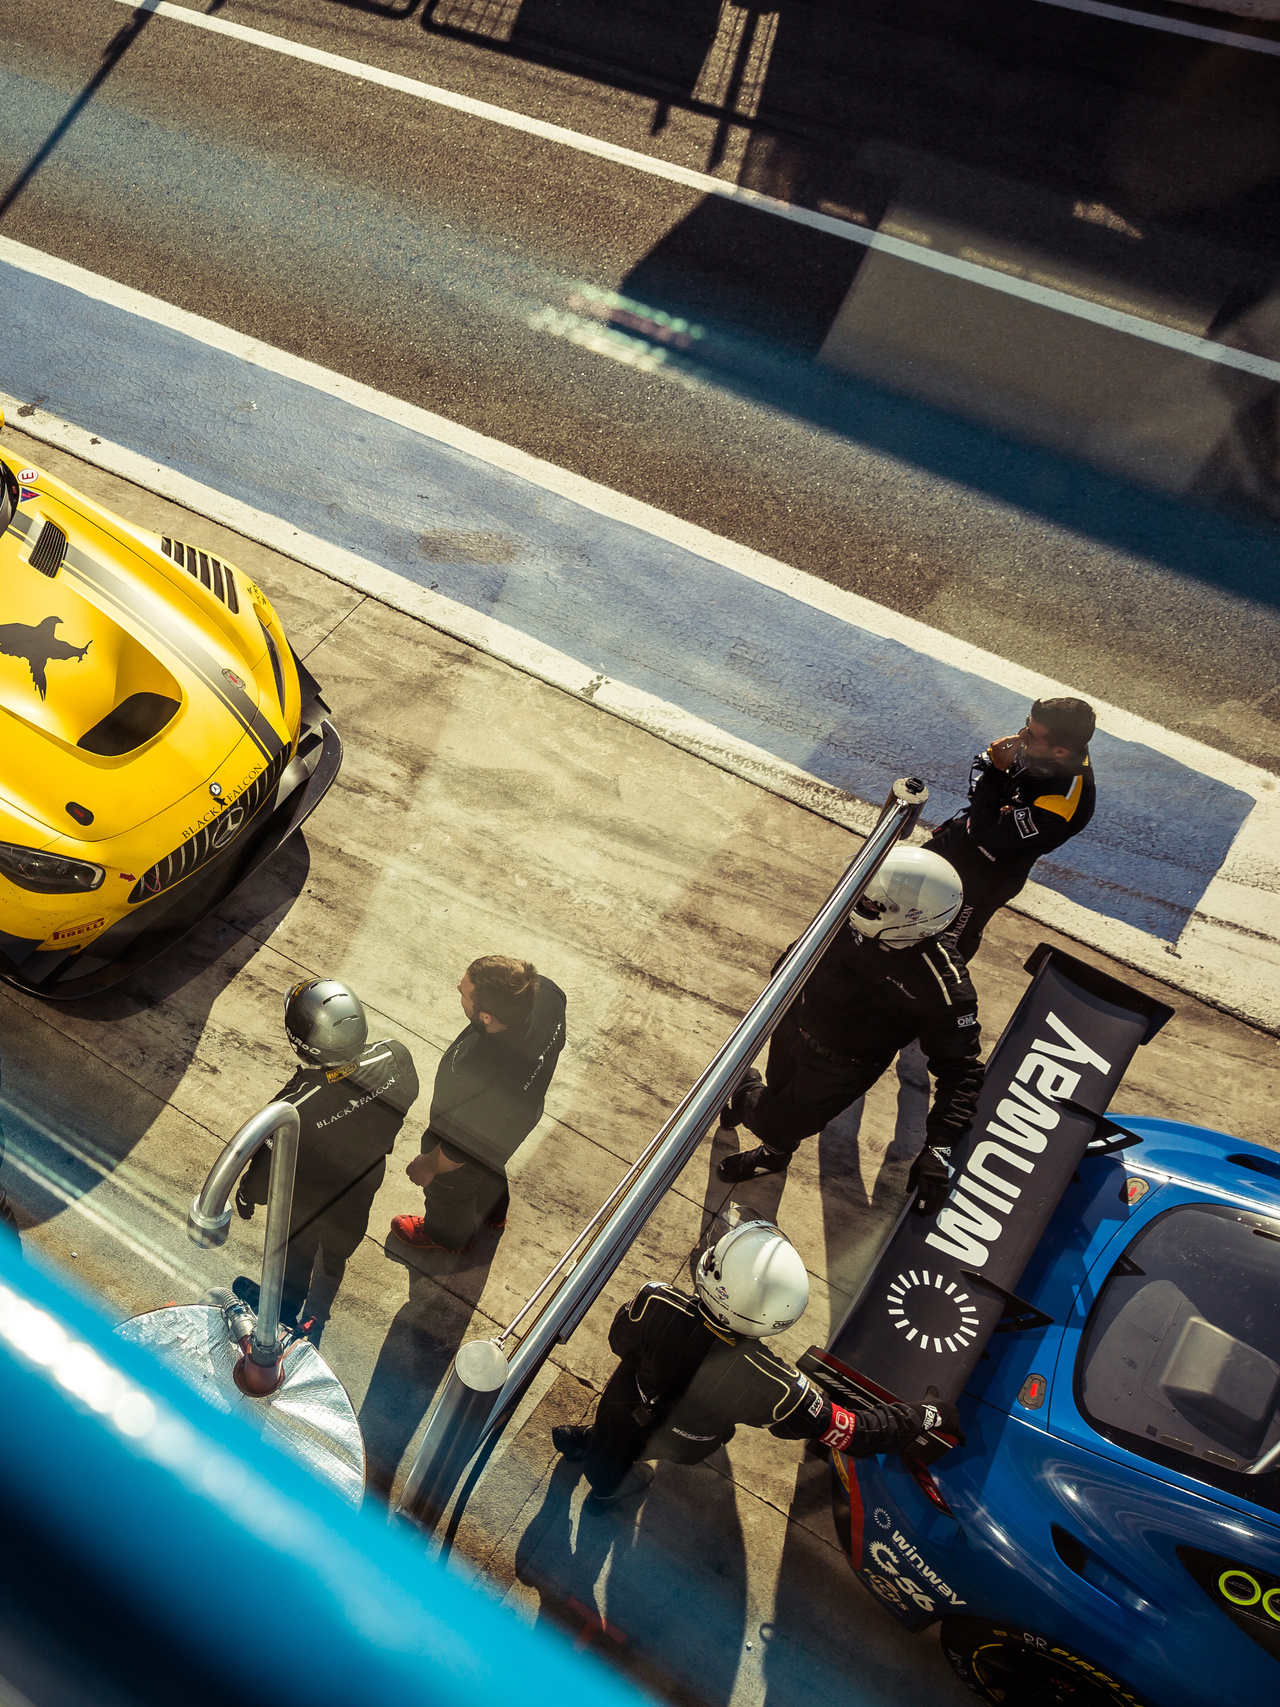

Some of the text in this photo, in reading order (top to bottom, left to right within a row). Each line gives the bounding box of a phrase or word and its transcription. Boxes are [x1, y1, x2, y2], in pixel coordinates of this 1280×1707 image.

[21, 471, 35, 481] E
[181, 763, 263, 839] BLACK FALCON
[53, 917, 104, 940] PIRELLI
[316, 1076, 396, 1129] BLACK FALCON
[924, 1011, 1112, 1267] winway
[863, 1568, 909, 1611] FUCHS
[892, 1530, 967, 1605] winway
